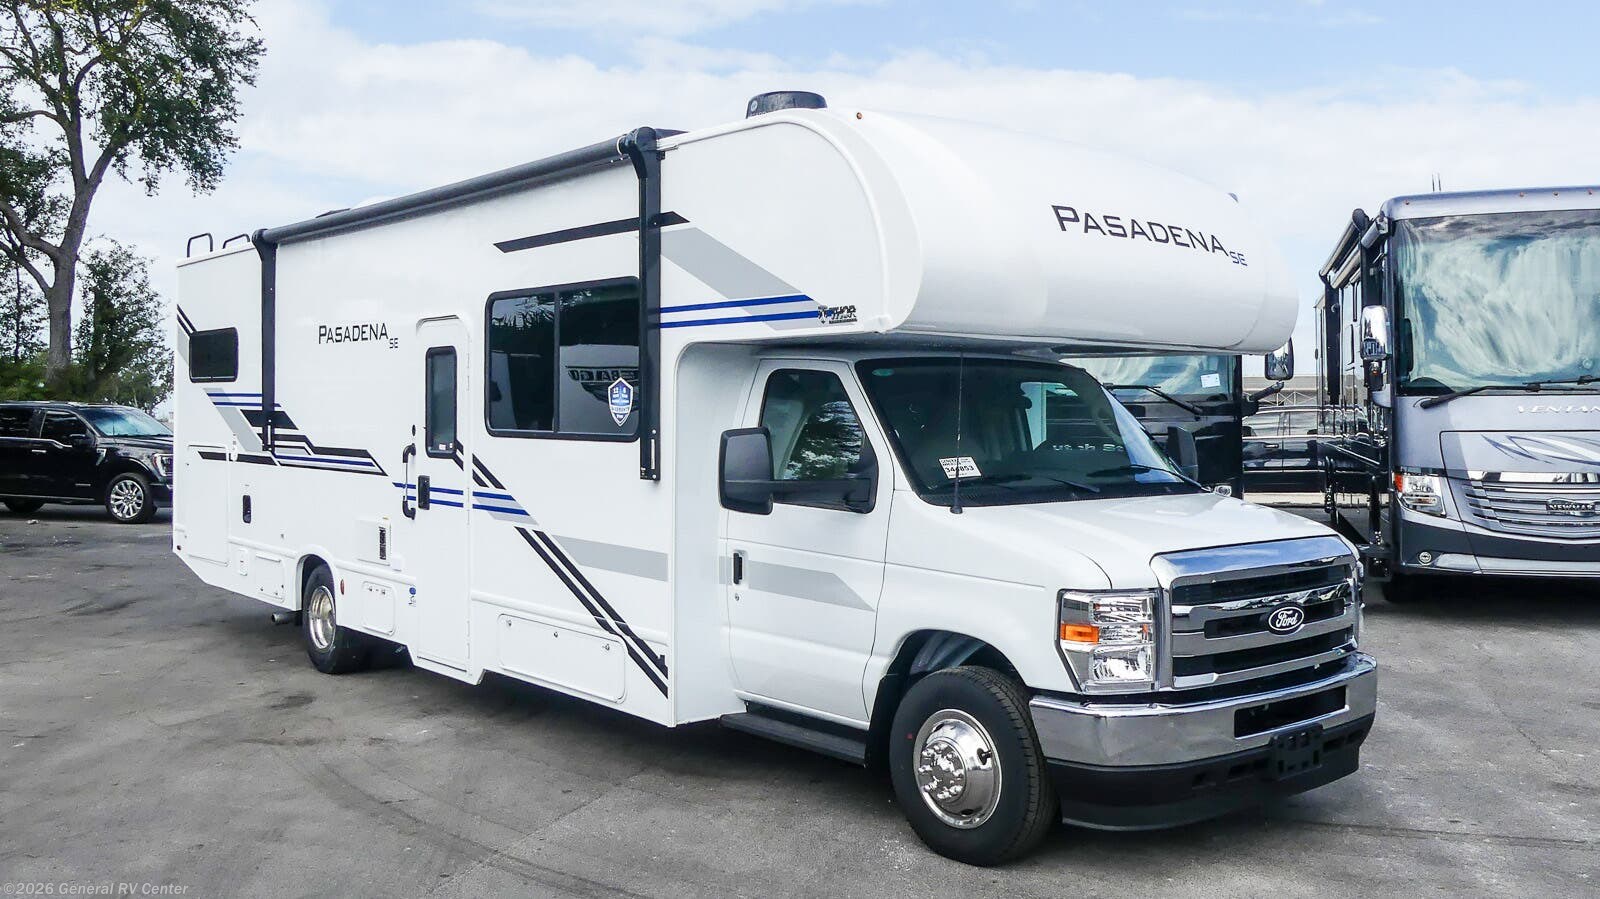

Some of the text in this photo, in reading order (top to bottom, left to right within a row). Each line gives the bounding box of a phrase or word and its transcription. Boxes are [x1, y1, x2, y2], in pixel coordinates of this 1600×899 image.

[1051, 205, 1248, 266] PASADENA SE
[318, 323, 389, 344] PASADENA
[1275, 610, 1299, 628] Ford
